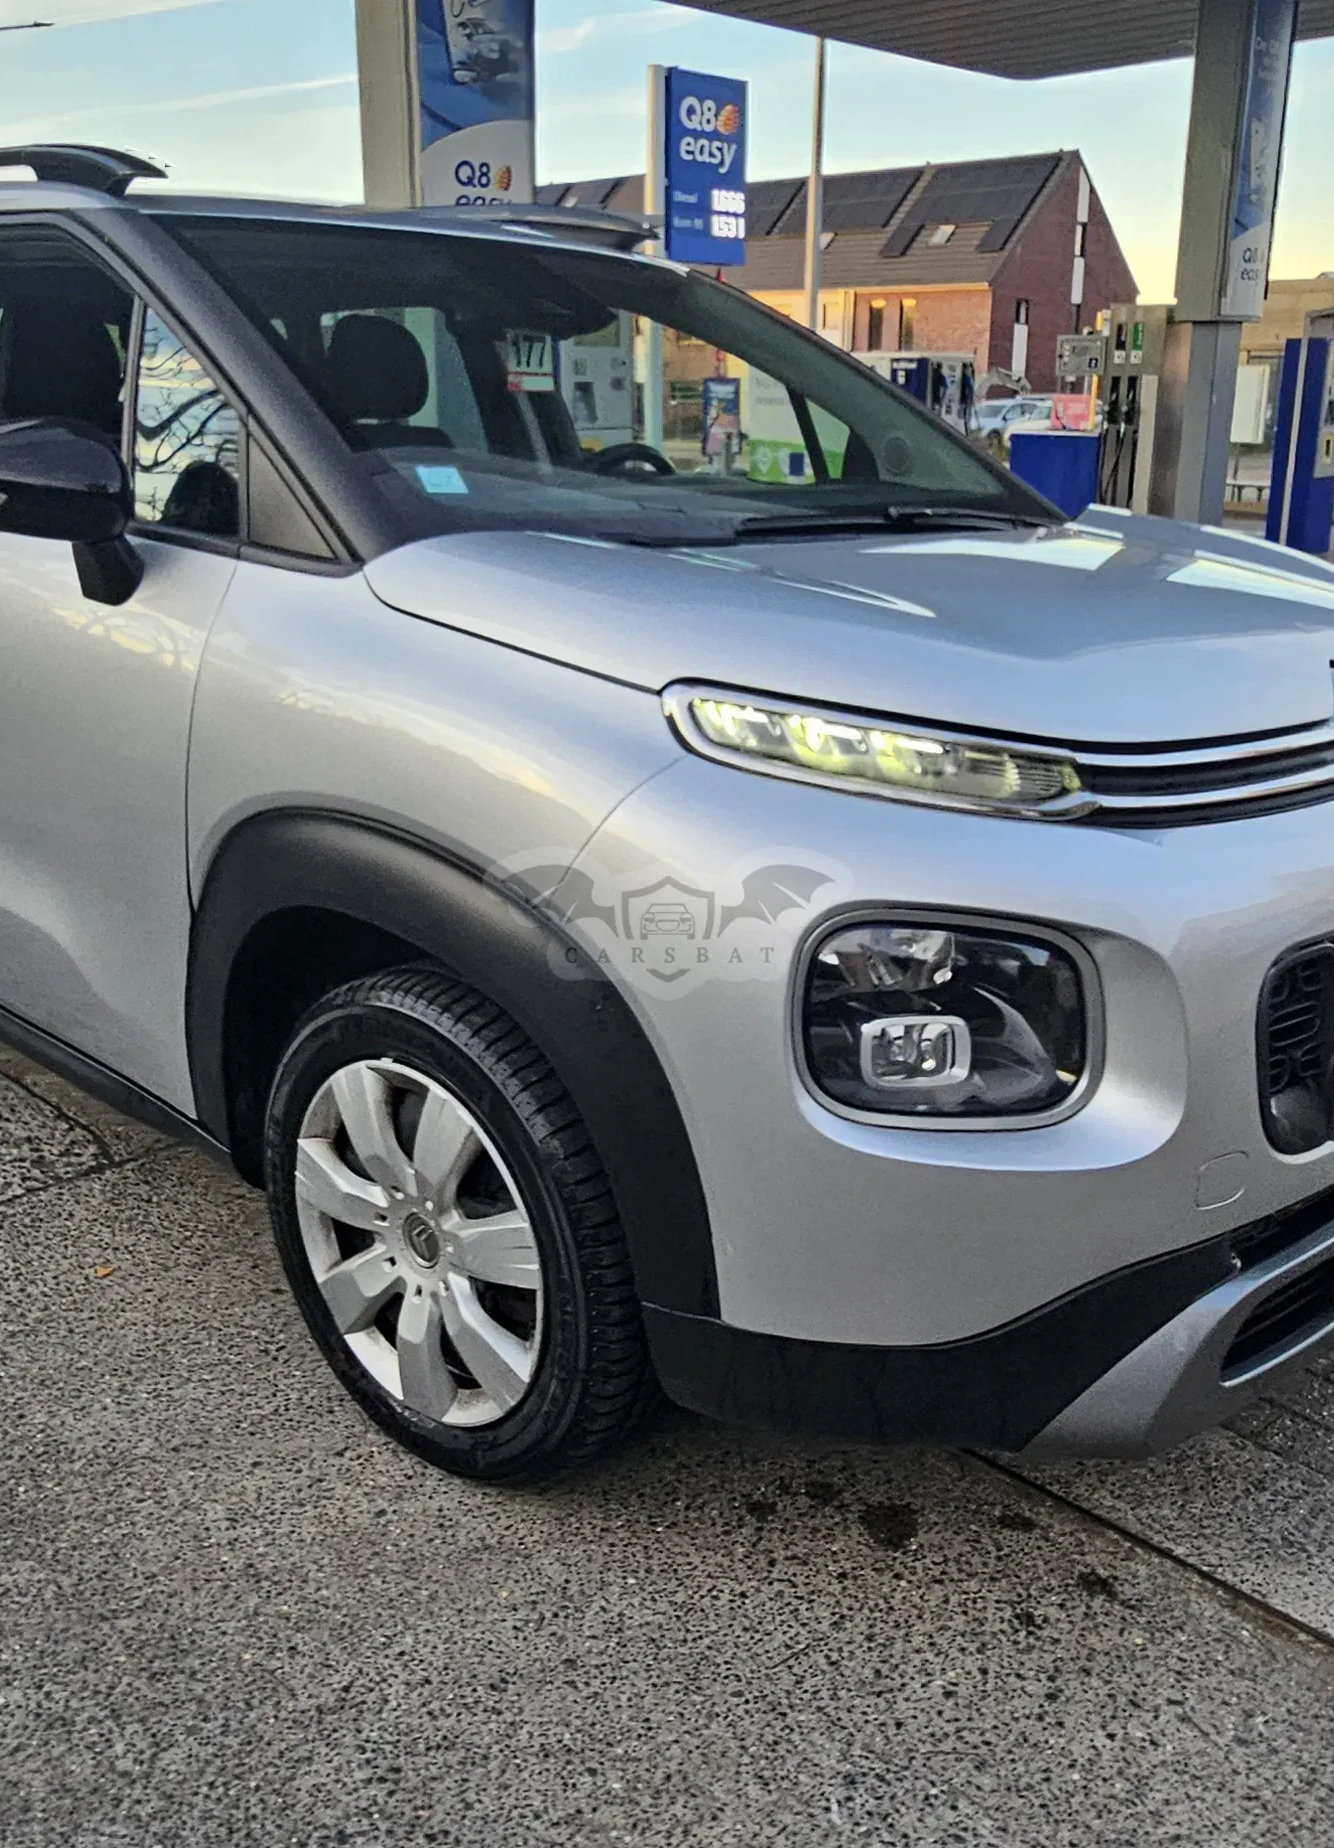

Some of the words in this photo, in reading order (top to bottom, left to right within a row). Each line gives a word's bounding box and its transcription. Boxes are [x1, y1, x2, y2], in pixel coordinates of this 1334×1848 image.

[680, 96, 717, 131] Q8
[679, 136, 737, 174] easy
[455, 160, 490, 188] Q8
